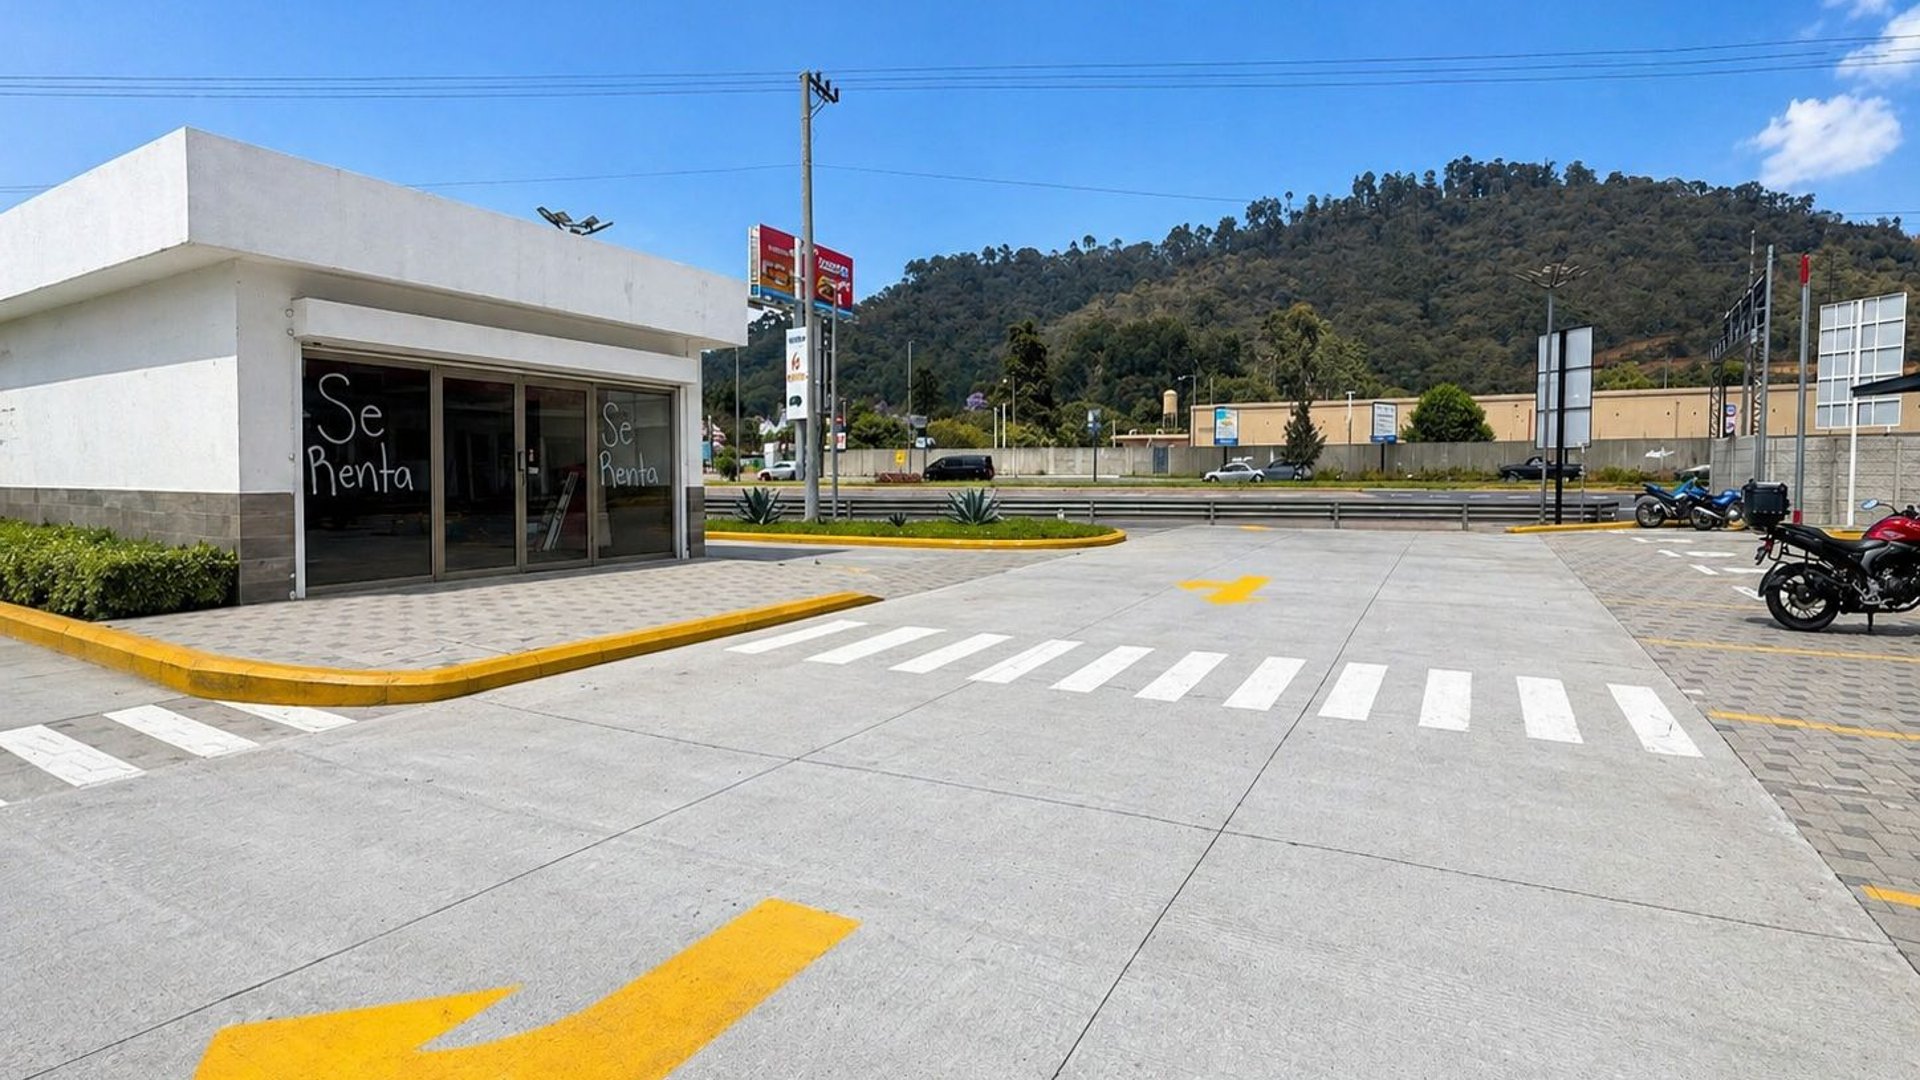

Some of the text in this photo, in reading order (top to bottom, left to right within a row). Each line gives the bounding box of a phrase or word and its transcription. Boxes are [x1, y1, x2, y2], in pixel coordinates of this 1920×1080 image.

[317, 372, 385, 444] Se
[602, 402, 633, 447] Se
[308, 442, 413, 496] Renta
[599, 451, 659, 488] Renta
